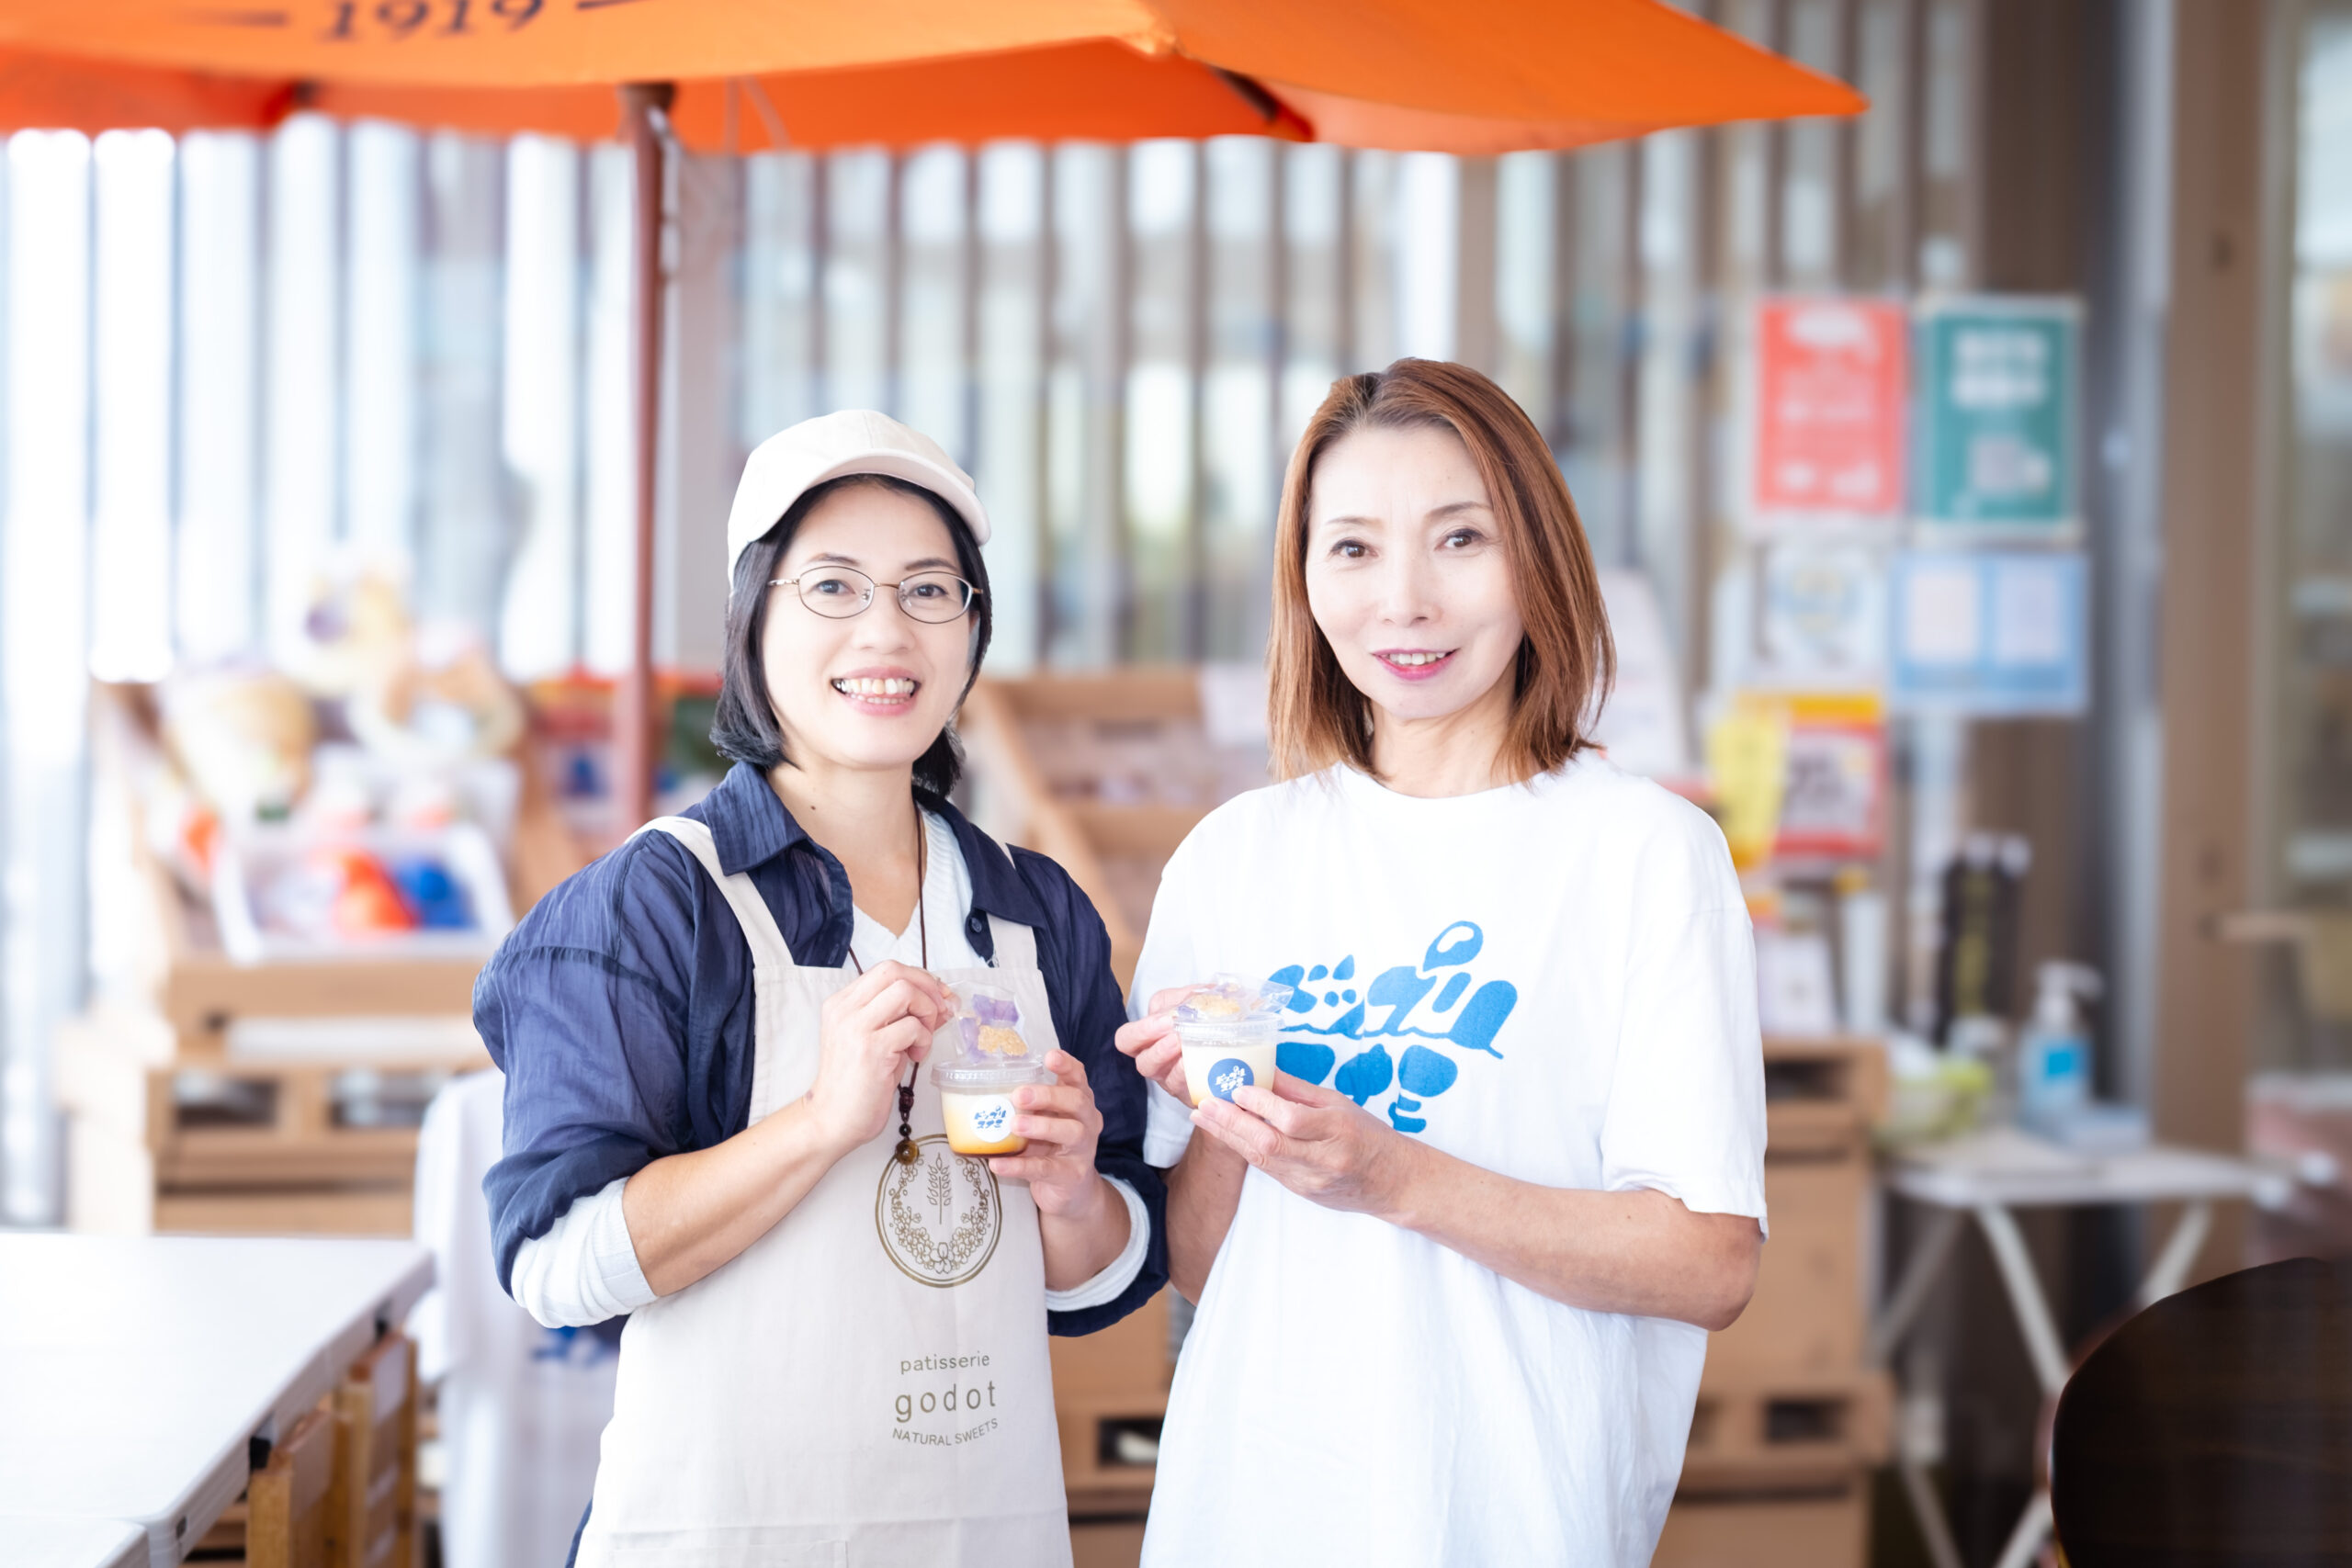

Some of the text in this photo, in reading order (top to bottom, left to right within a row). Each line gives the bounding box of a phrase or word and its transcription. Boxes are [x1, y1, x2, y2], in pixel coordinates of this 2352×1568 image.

[900, 1350, 990, 1375] patisserie
[895, 1380, 996, 1423] godot
[892, 1417, 999, 1446] NATURAL SWEETS
